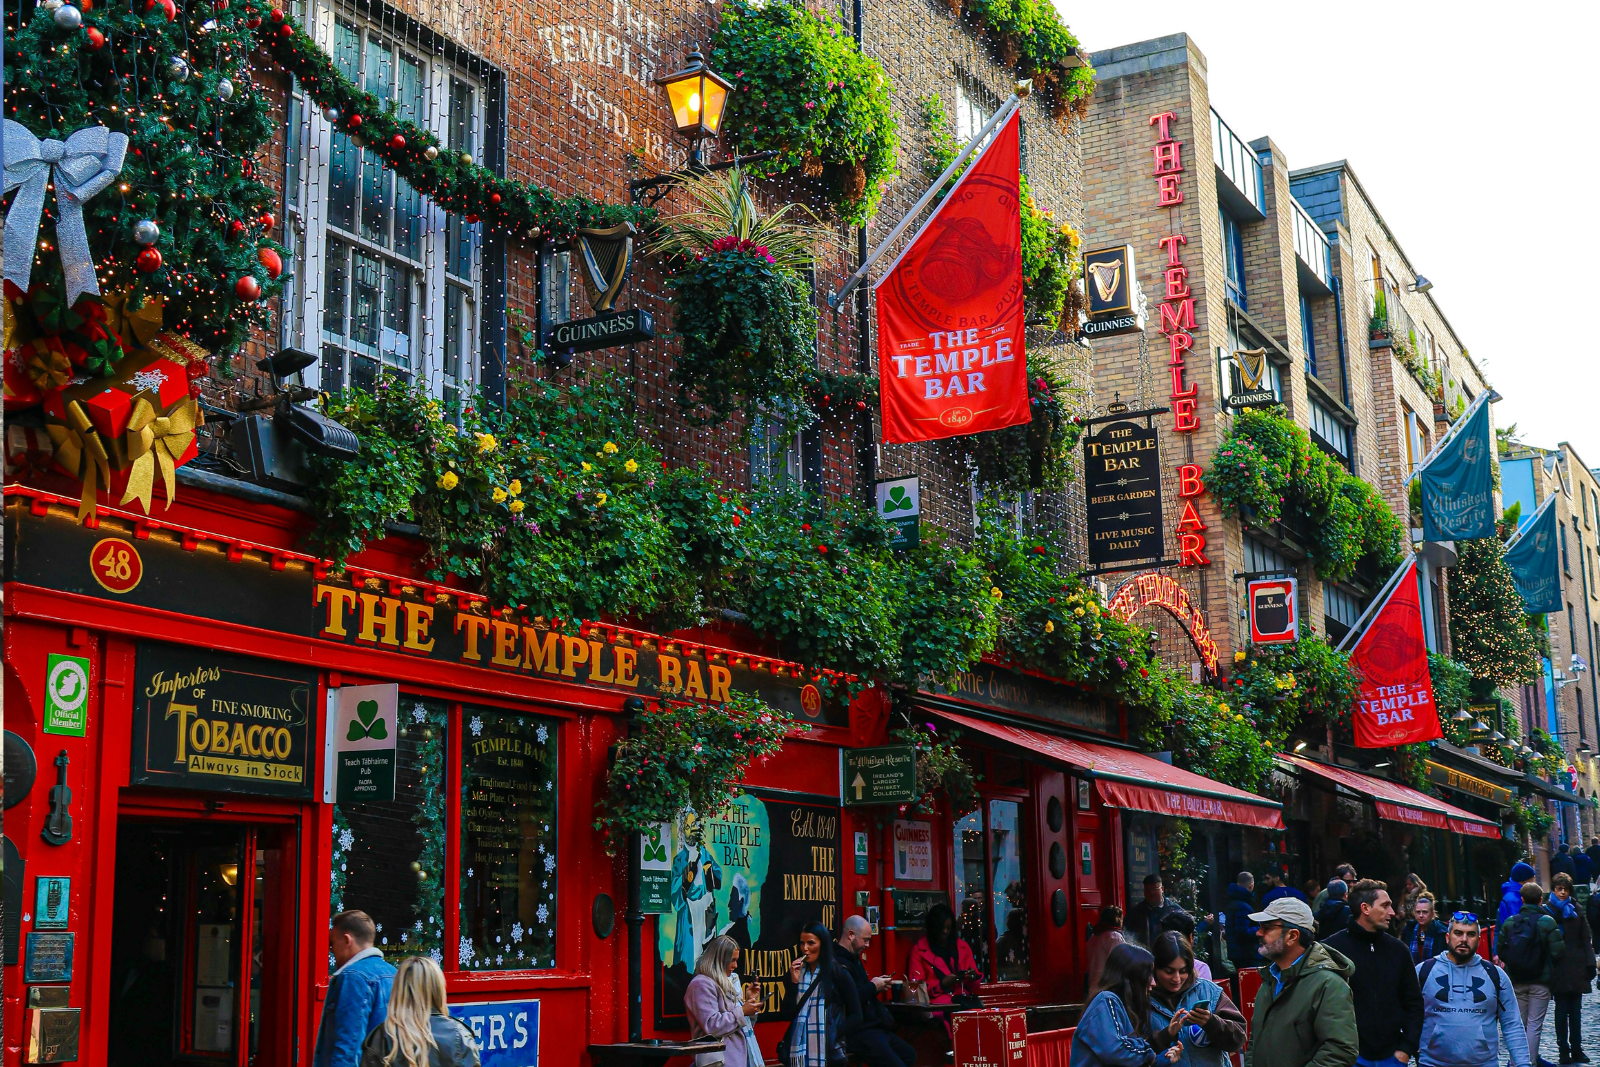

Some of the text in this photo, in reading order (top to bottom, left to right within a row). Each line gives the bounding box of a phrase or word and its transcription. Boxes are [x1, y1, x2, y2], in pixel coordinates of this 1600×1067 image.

[557, 316, 635, 343] GUINNESS
[1085, 317, 1136, 334] GUINNESS
[929, 328, 979, 350] THE
[1149, 111, 1211, 567] THE TEMPLE BAR
[891, 338, 1014, 378] TEMPLE
[924, 372, 987, 400] BAR
[1229, 391, 1273, 406] GUINNESS
[947, 415, 967, 424] 1840
[1109, 428, 1133, 439] THE
[1087, 438, 1156, 458] TEMPLE
[1104, 457, 1141, 472] BAR
[1091, 489, 1156, 505] BEER GARDEN
[1428, 490, 1488, 516] Whiskey
[1095, 526, 1155, 541] LIVE MUSIC
[1109, 539, 1142, 551] DAILY
[99, 545, 132, 580] 48
[1135, 572, 1190, 620] TEMPLE
[1190, 607, 1219, 677] BAR
[314, 583, 733, 703] THE TEMPLE BAR
[145, 665, 221, 702] Importers
[1376, 684, 1406, 698] THE
[192, 688, 206, 699] OF
[804, 690, 816, 710] 48
[1357, 690, 1429, 714] TEMPLE
[54, 709, 79, 719] Official
[211, 698, 292, 722] FINE SMOKING
[1376, 707, 1415, 726] BAR
[52, 717, 81, 728] Member
[164, 700, 292, 764] TOBACCO
[471, 737, 548, 764] TEMPLE BAR
[190, 755, 301, 780] Always in Stock
[344, 758, 361, 766] Teach
[360, 767, 372, 775] Pub
[510, 758, 524, 768] 1840
[856, 755, 885, 769] Whiskey
[885, 754, 911, 767] Reserve
[479, 776, 511, 789] Traditional
[472, 790, 488, 801] Meat
[1165, 791, 1223, 816] THE TEMPLE BAR
[709, 823, 762, 847] TEMPLE
[816, 815, 836, 840] 1840
[895, 823, 930, 843] GUINNESS
[474, 852, 487, 863] Hot
[723, 845, 751, 869] BAR
[810, 845, 835, 873] THE
[908, 844, 929, 856] IS GOOD
[909, 857, 929, 868] FOR YOU
[783, 873, 836, 903] EMPEROR
[822, 904, 836, 931] OF
[743, 948, 791, 978] MALTED
[1008, 1039, 1026, 1050] TEMPLE
[1012, 1032, 1021, 1040] THE
[1013, 1050, 1023, 1060] BAR
